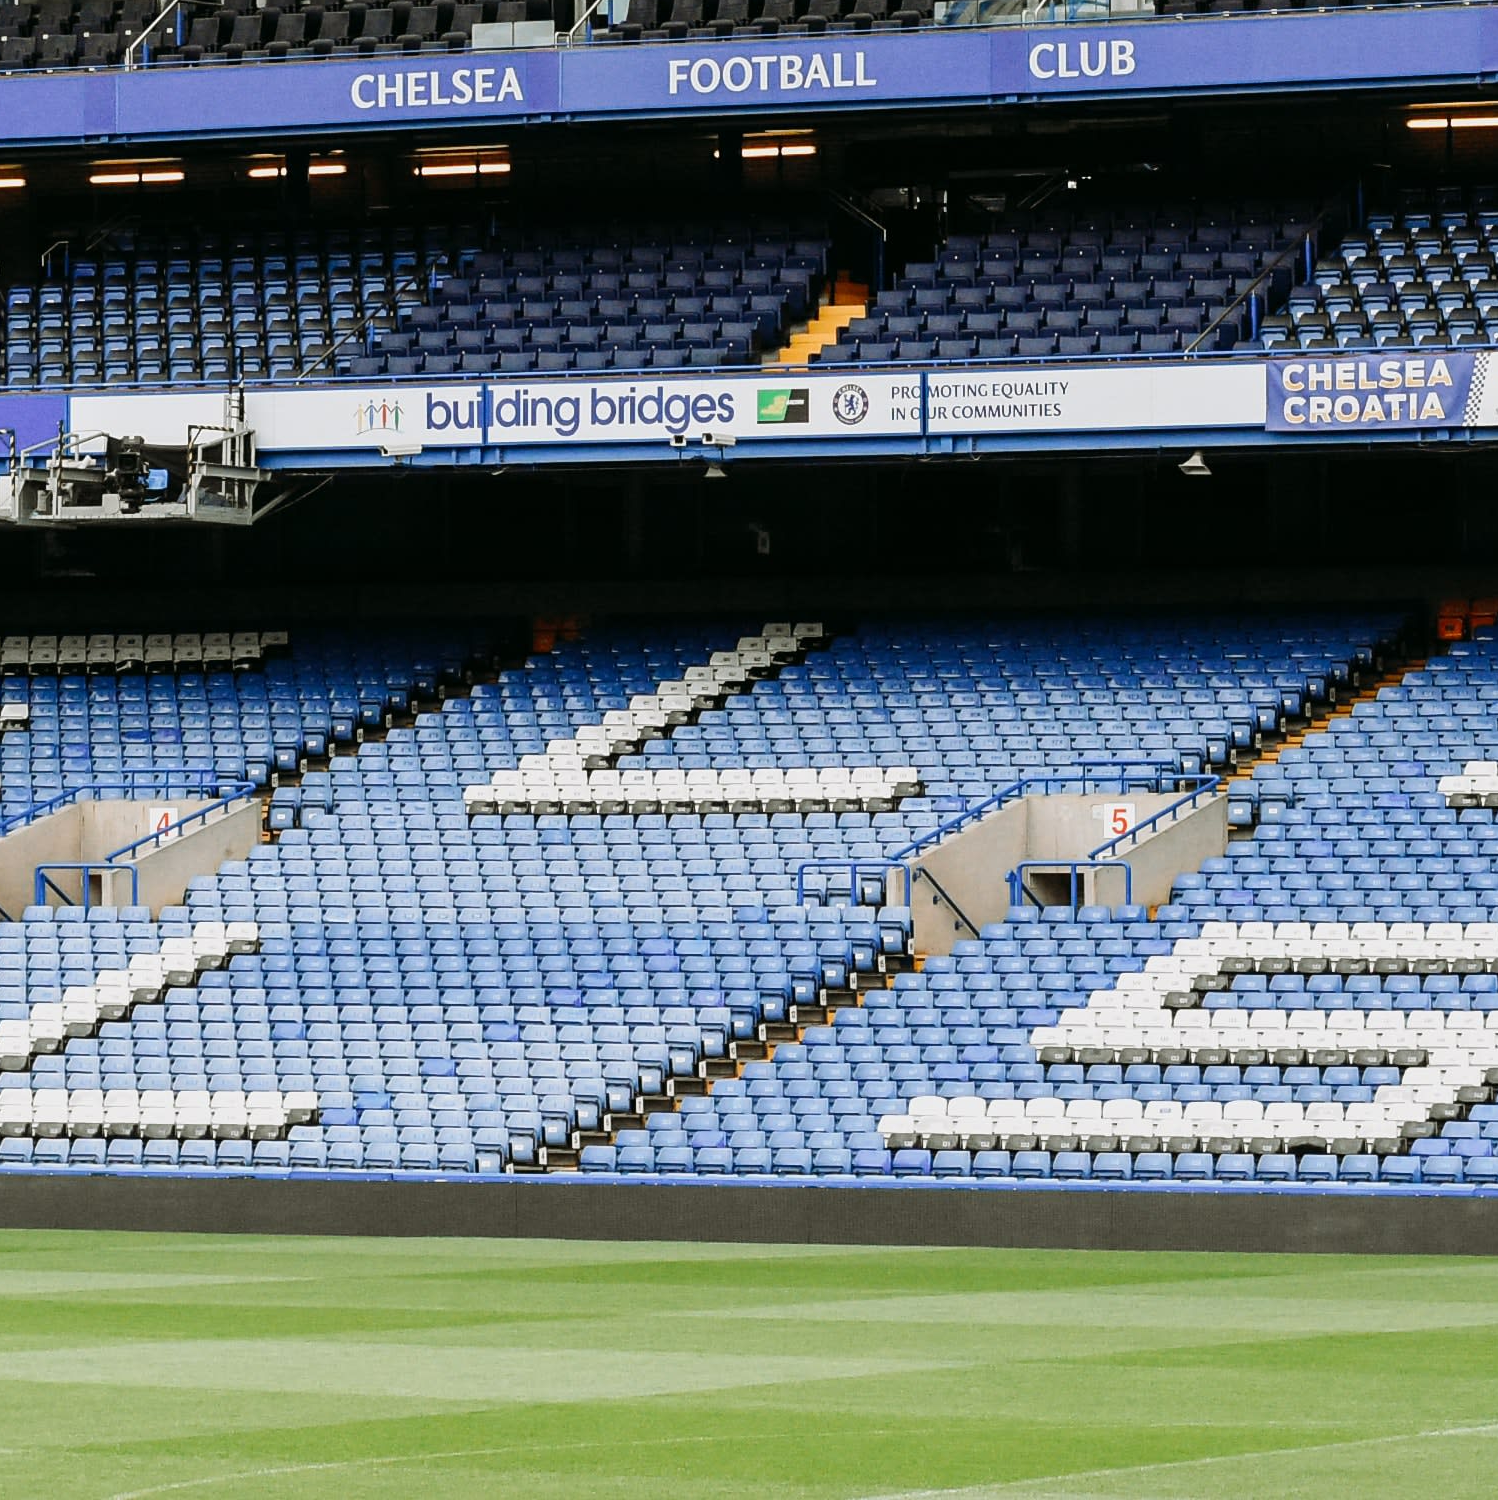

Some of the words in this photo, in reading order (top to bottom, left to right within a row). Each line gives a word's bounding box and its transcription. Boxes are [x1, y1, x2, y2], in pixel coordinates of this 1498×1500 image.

[349, 67, 524, 110] CHELSEA
[667, 52, 877, 95] FOOTBALL
[1028, 40, 1137, 80] CLUB
[891, 384, 988, 400] PROMOTING
[992, 381, 1069, 398] EQUALITY
[1282, 359, 1453, 392] CHELSEA
[426, 389, 581, 436] building
[590, 387, 736, 435] bridges
[891, 407, 906, 421] IN
[910, 404, 948, 421] OUR
[952, 403, 1062, 419] COMMUNITIES
[1283, 392, 1446, 424] CROATIA
[156, 811, 170, 838] 4
[1111, 807, 1128, 835] 5
